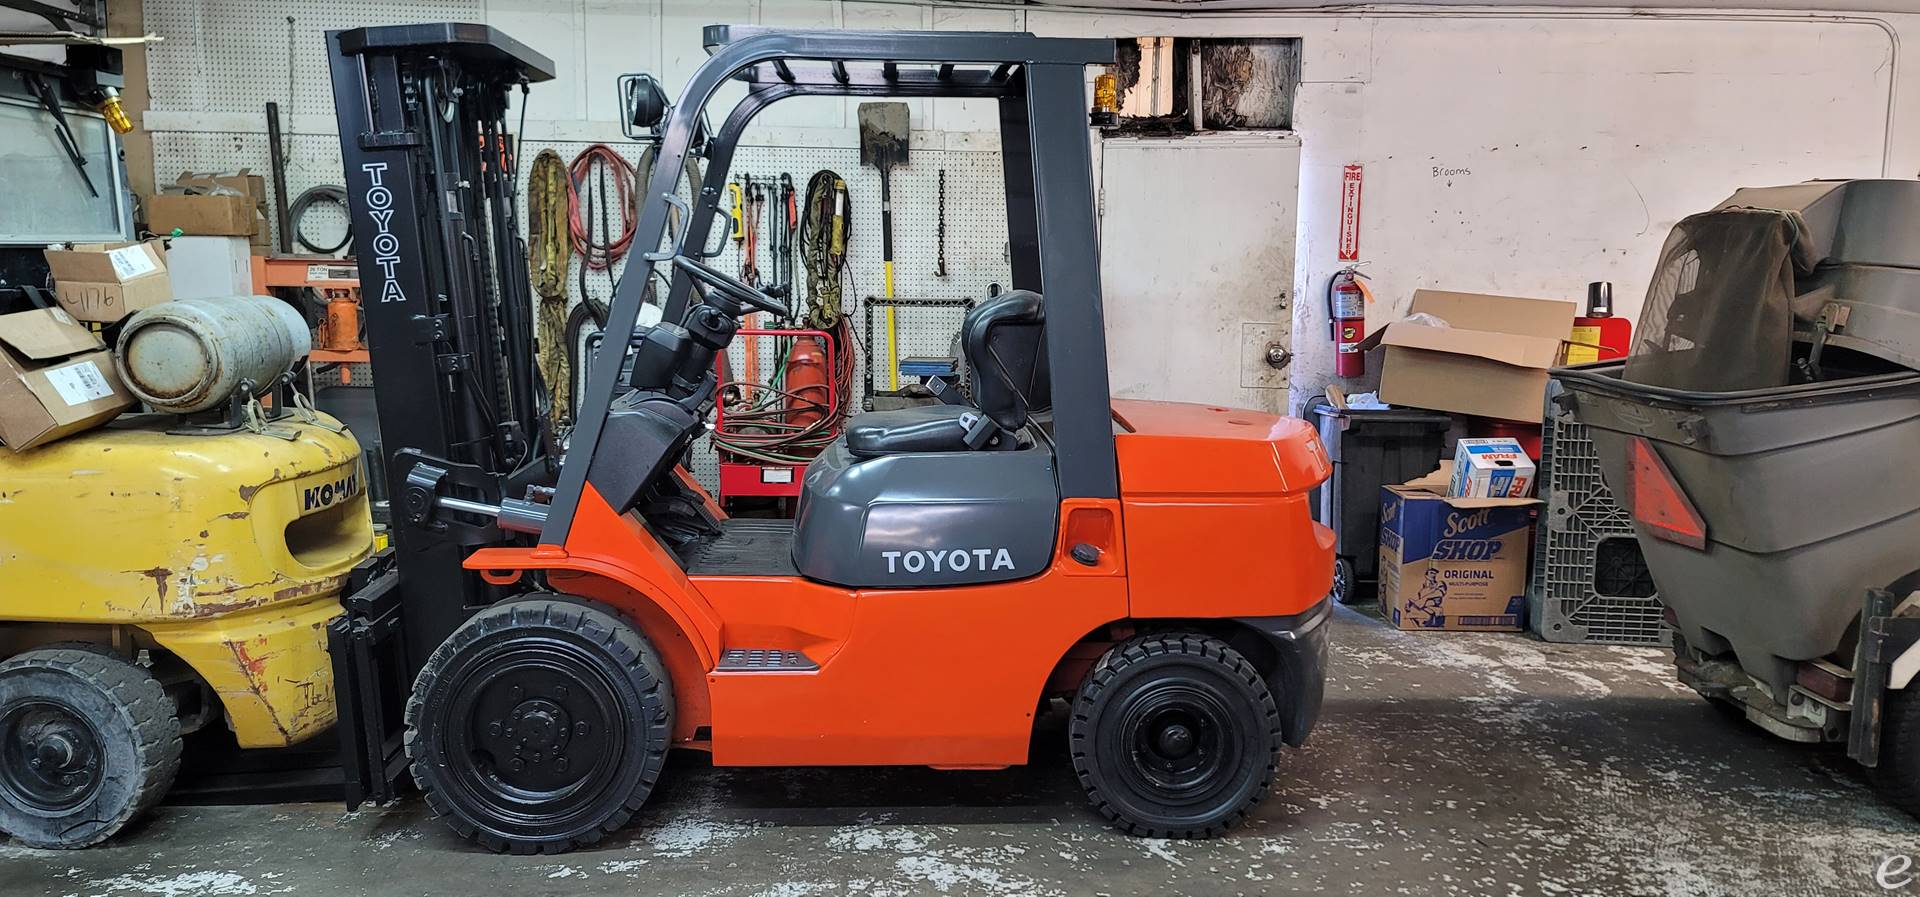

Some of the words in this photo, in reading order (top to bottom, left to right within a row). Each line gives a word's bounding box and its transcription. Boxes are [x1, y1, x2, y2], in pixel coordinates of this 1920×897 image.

[1345, 172, 1361, 181] FIRE
[1432, 166, 1472, 178] Brooms
[1345, 182, 1355, 256] EXTINGUISHER
[362, 162, 407, 303] TOYOTA
[1443, 508, 1491, 538] Scott
[881, 548, 1016, 573] TOYOTA
[1432, 540, 1504, 561] SHOP
[1444, 569, 1495, 580] ORIGINAL
